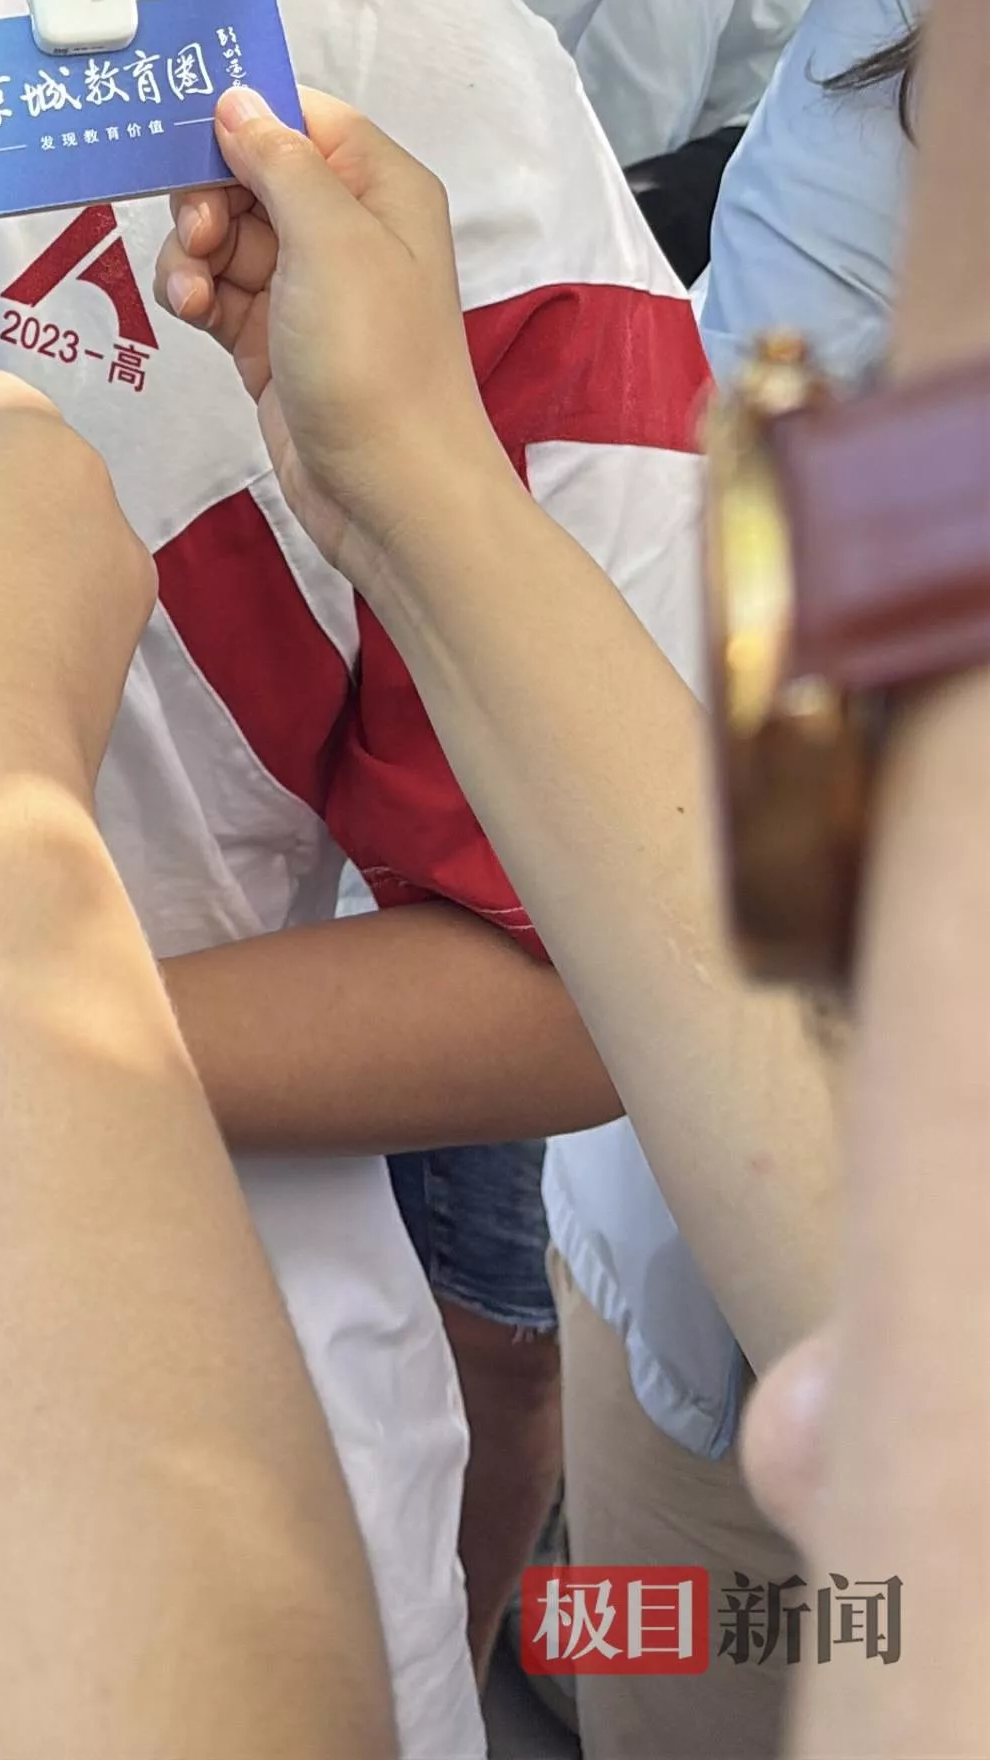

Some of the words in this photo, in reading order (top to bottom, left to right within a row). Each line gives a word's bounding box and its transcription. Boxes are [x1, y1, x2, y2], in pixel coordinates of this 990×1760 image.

[40, 118, 164, 151] 发现教育价值
